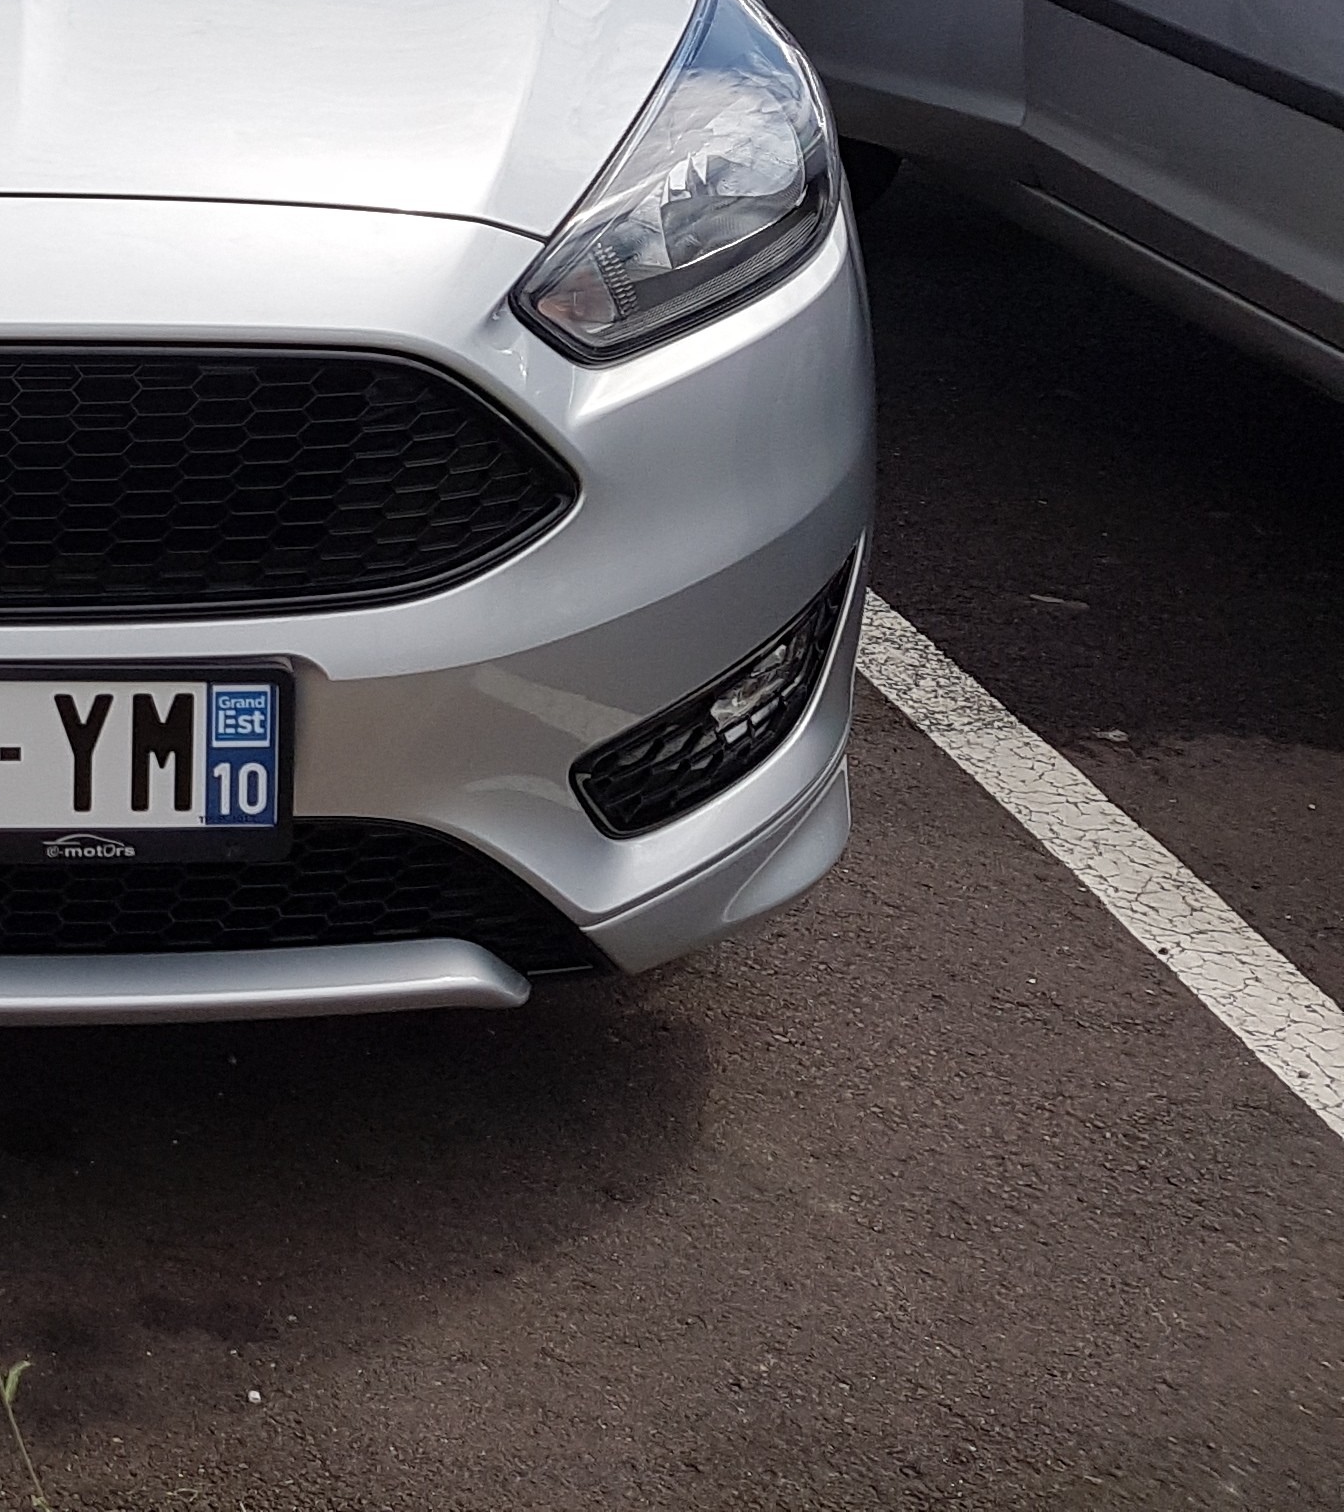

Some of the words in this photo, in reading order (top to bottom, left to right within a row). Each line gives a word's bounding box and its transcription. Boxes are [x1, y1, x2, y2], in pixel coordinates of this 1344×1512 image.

[218, 695, 266, 709] Grand
[217, 709, 266, 734] Est
[213, 761, 268, 815] 10
